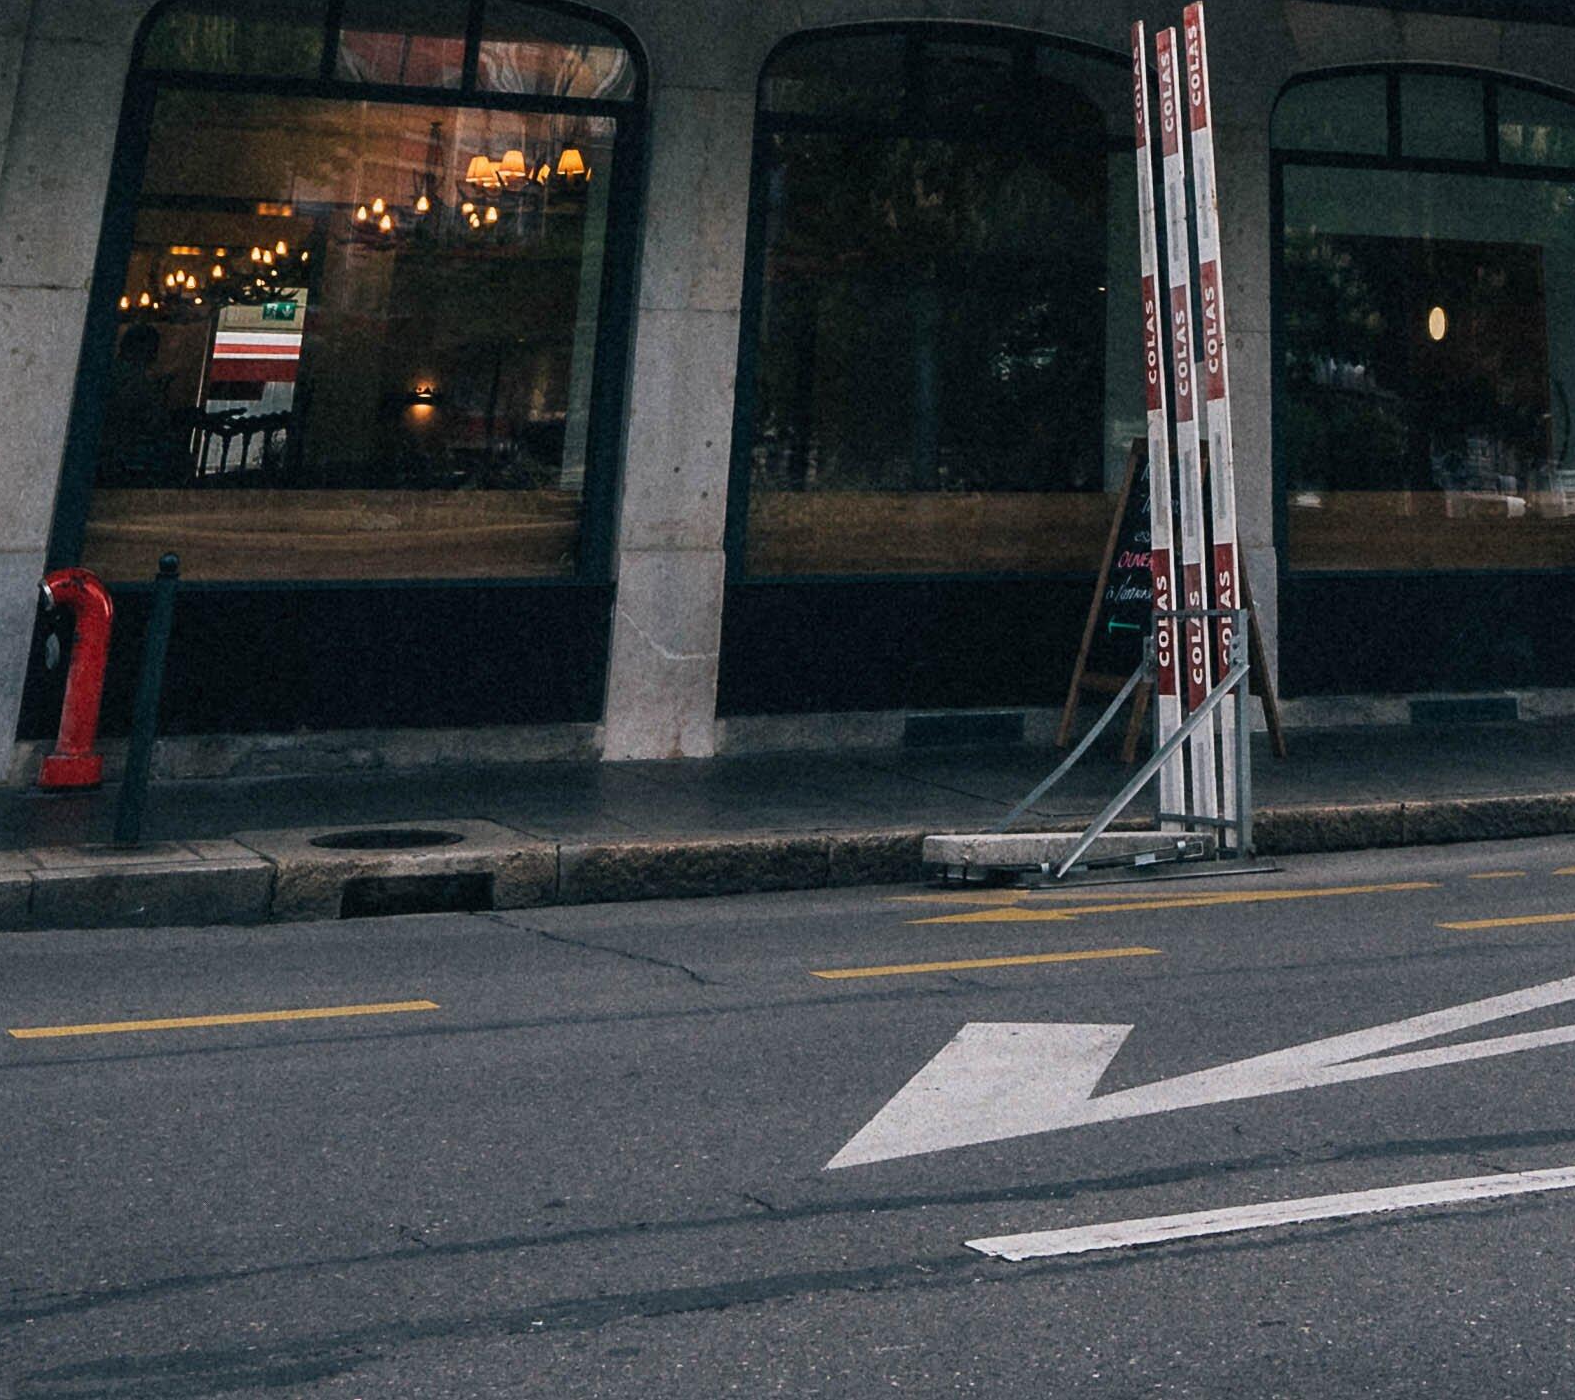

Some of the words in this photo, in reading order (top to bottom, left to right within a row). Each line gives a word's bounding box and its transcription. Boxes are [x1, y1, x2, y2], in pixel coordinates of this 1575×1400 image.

[1132, 45, 1144, 125] COLAS
[1159, 52, 1175, 133] COLAS
[1187, 24, 1202, 107] COLAS
[1145, 299, 1157, 385] COLAS
[1175, 309, 1189, 397] COLAS
[1204, 286, 1219, 375] COLAS
[1156, 575, 1170, 667] COLAS
[1190, 590, 1203, 685] COLAS
